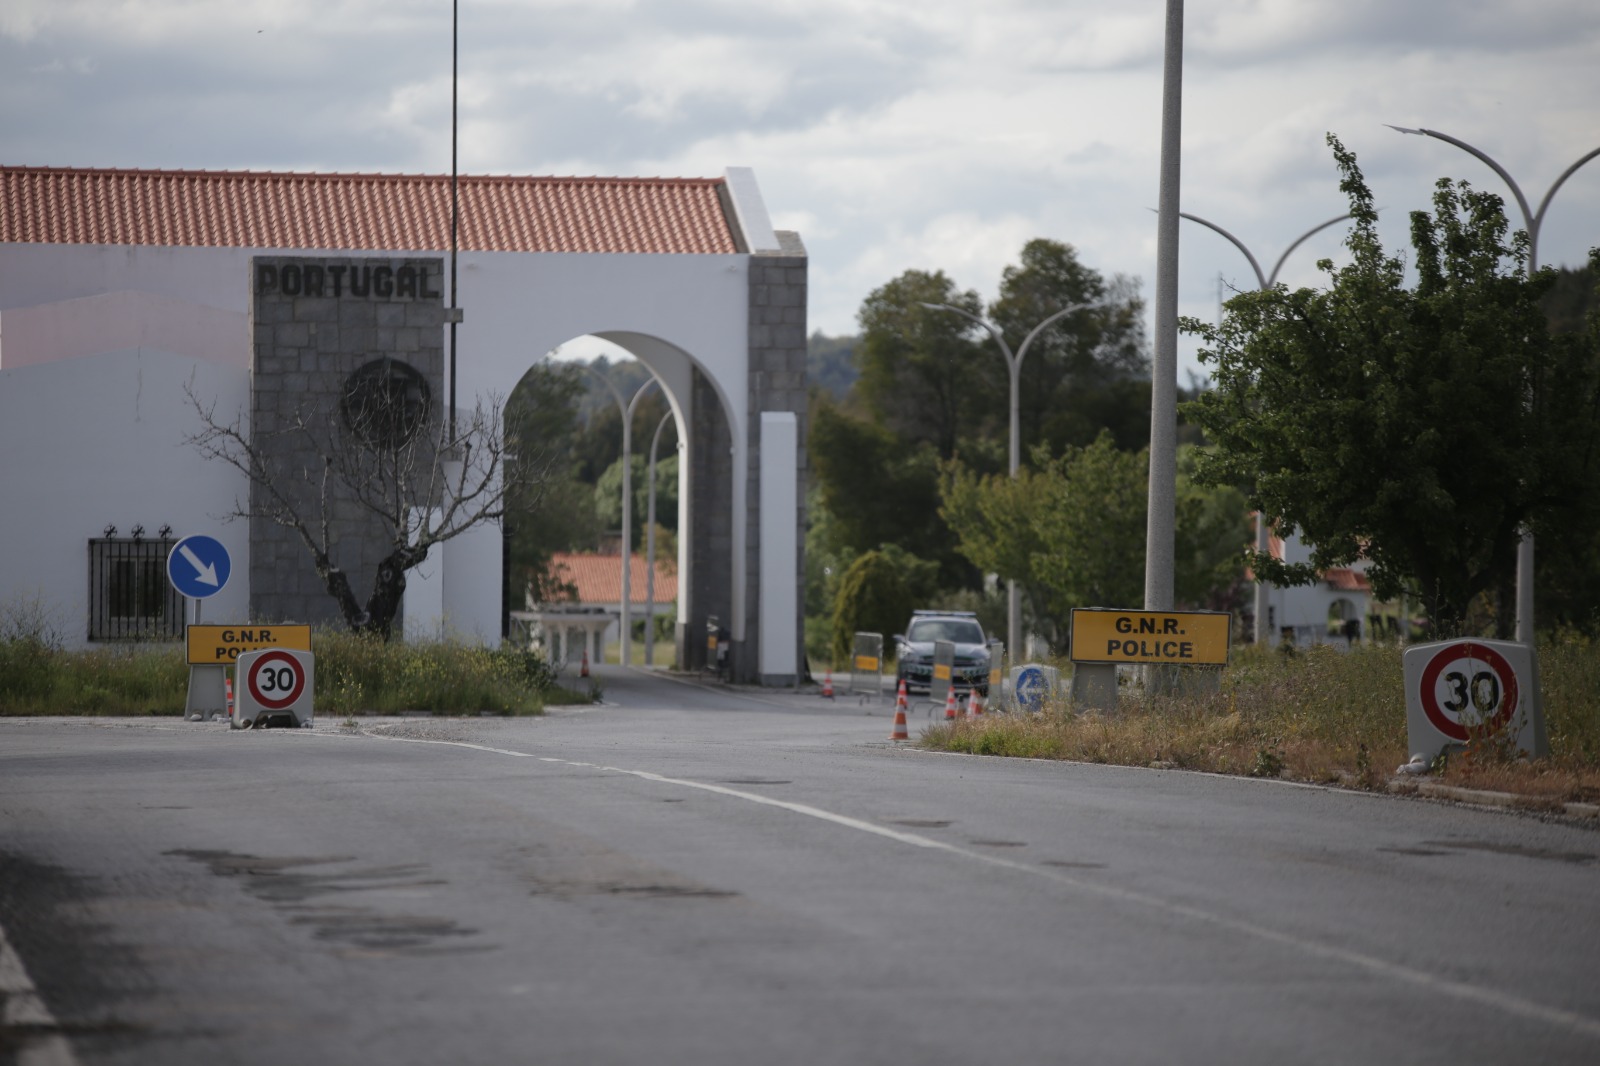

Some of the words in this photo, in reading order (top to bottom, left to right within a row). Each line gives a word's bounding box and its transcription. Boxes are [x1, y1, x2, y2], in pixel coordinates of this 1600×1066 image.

[257, 264, 439, 297] PORTUGAL
[221, 630, 277, 643] G.N.R.
[1115, 617, 1185, 635] G.N.R.
[1107, 640, 1193, 658] POLICE
[261, 667, 294, 692] 30
[1443, 671, 1500, 712] 30
